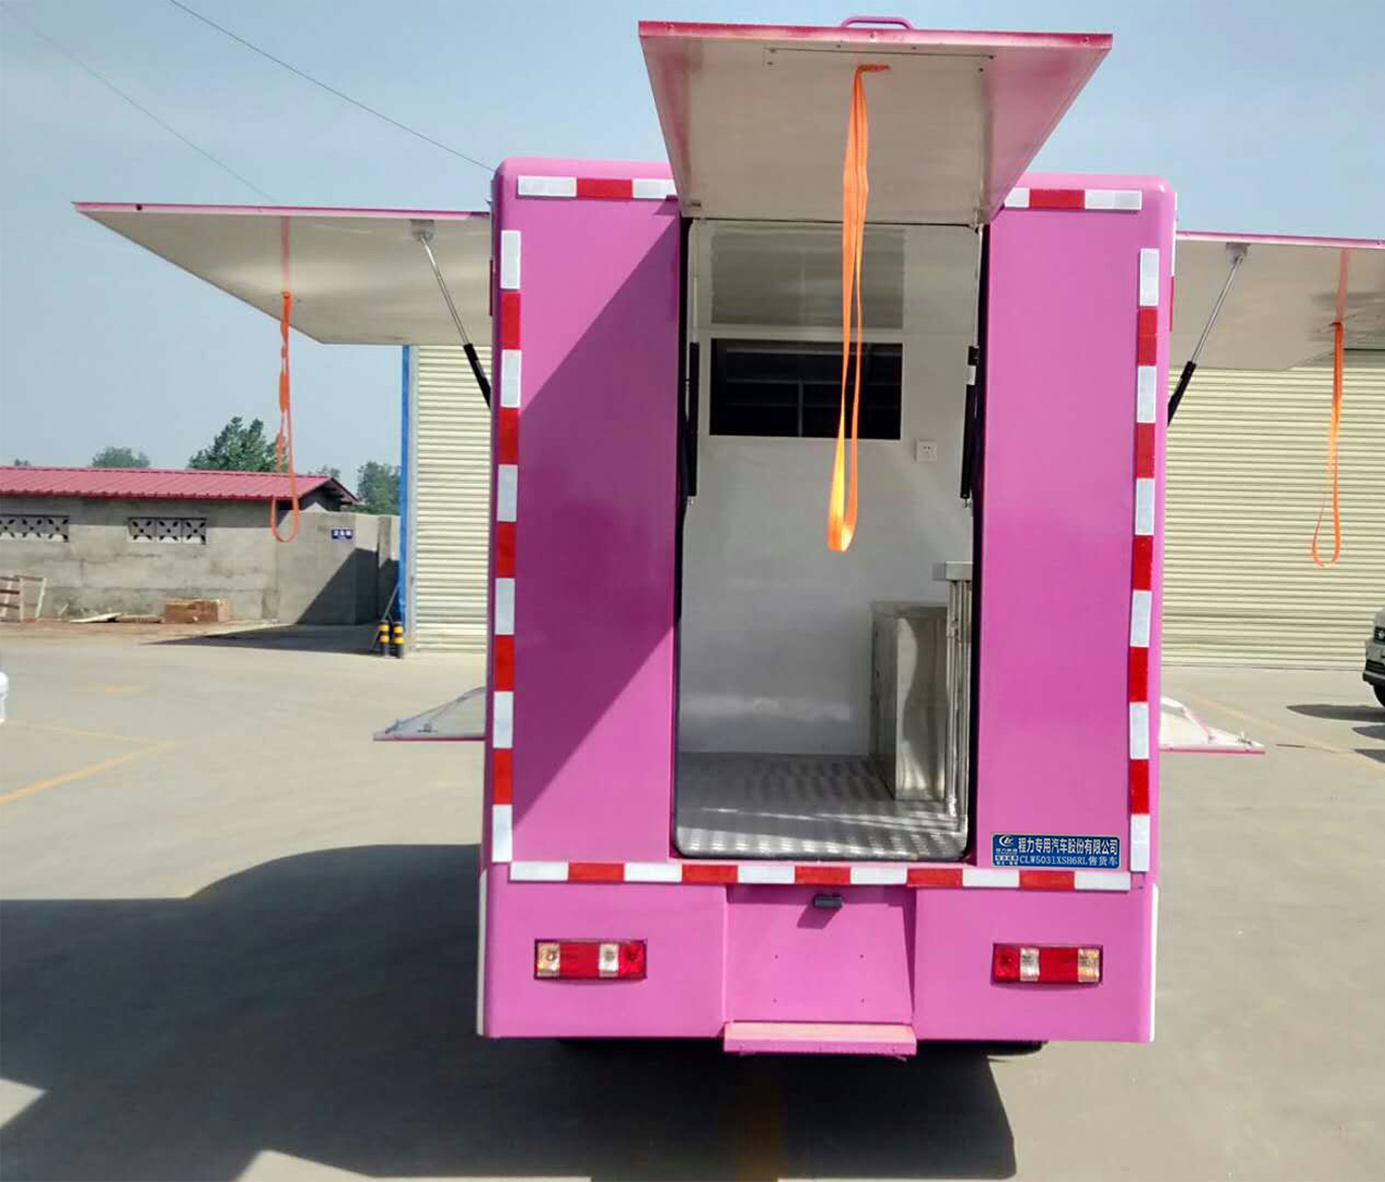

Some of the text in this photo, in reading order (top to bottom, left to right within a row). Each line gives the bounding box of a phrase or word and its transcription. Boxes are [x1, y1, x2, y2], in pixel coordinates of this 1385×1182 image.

[1018, 837, 1118, 855] 程力专用汽车股份有限公司
